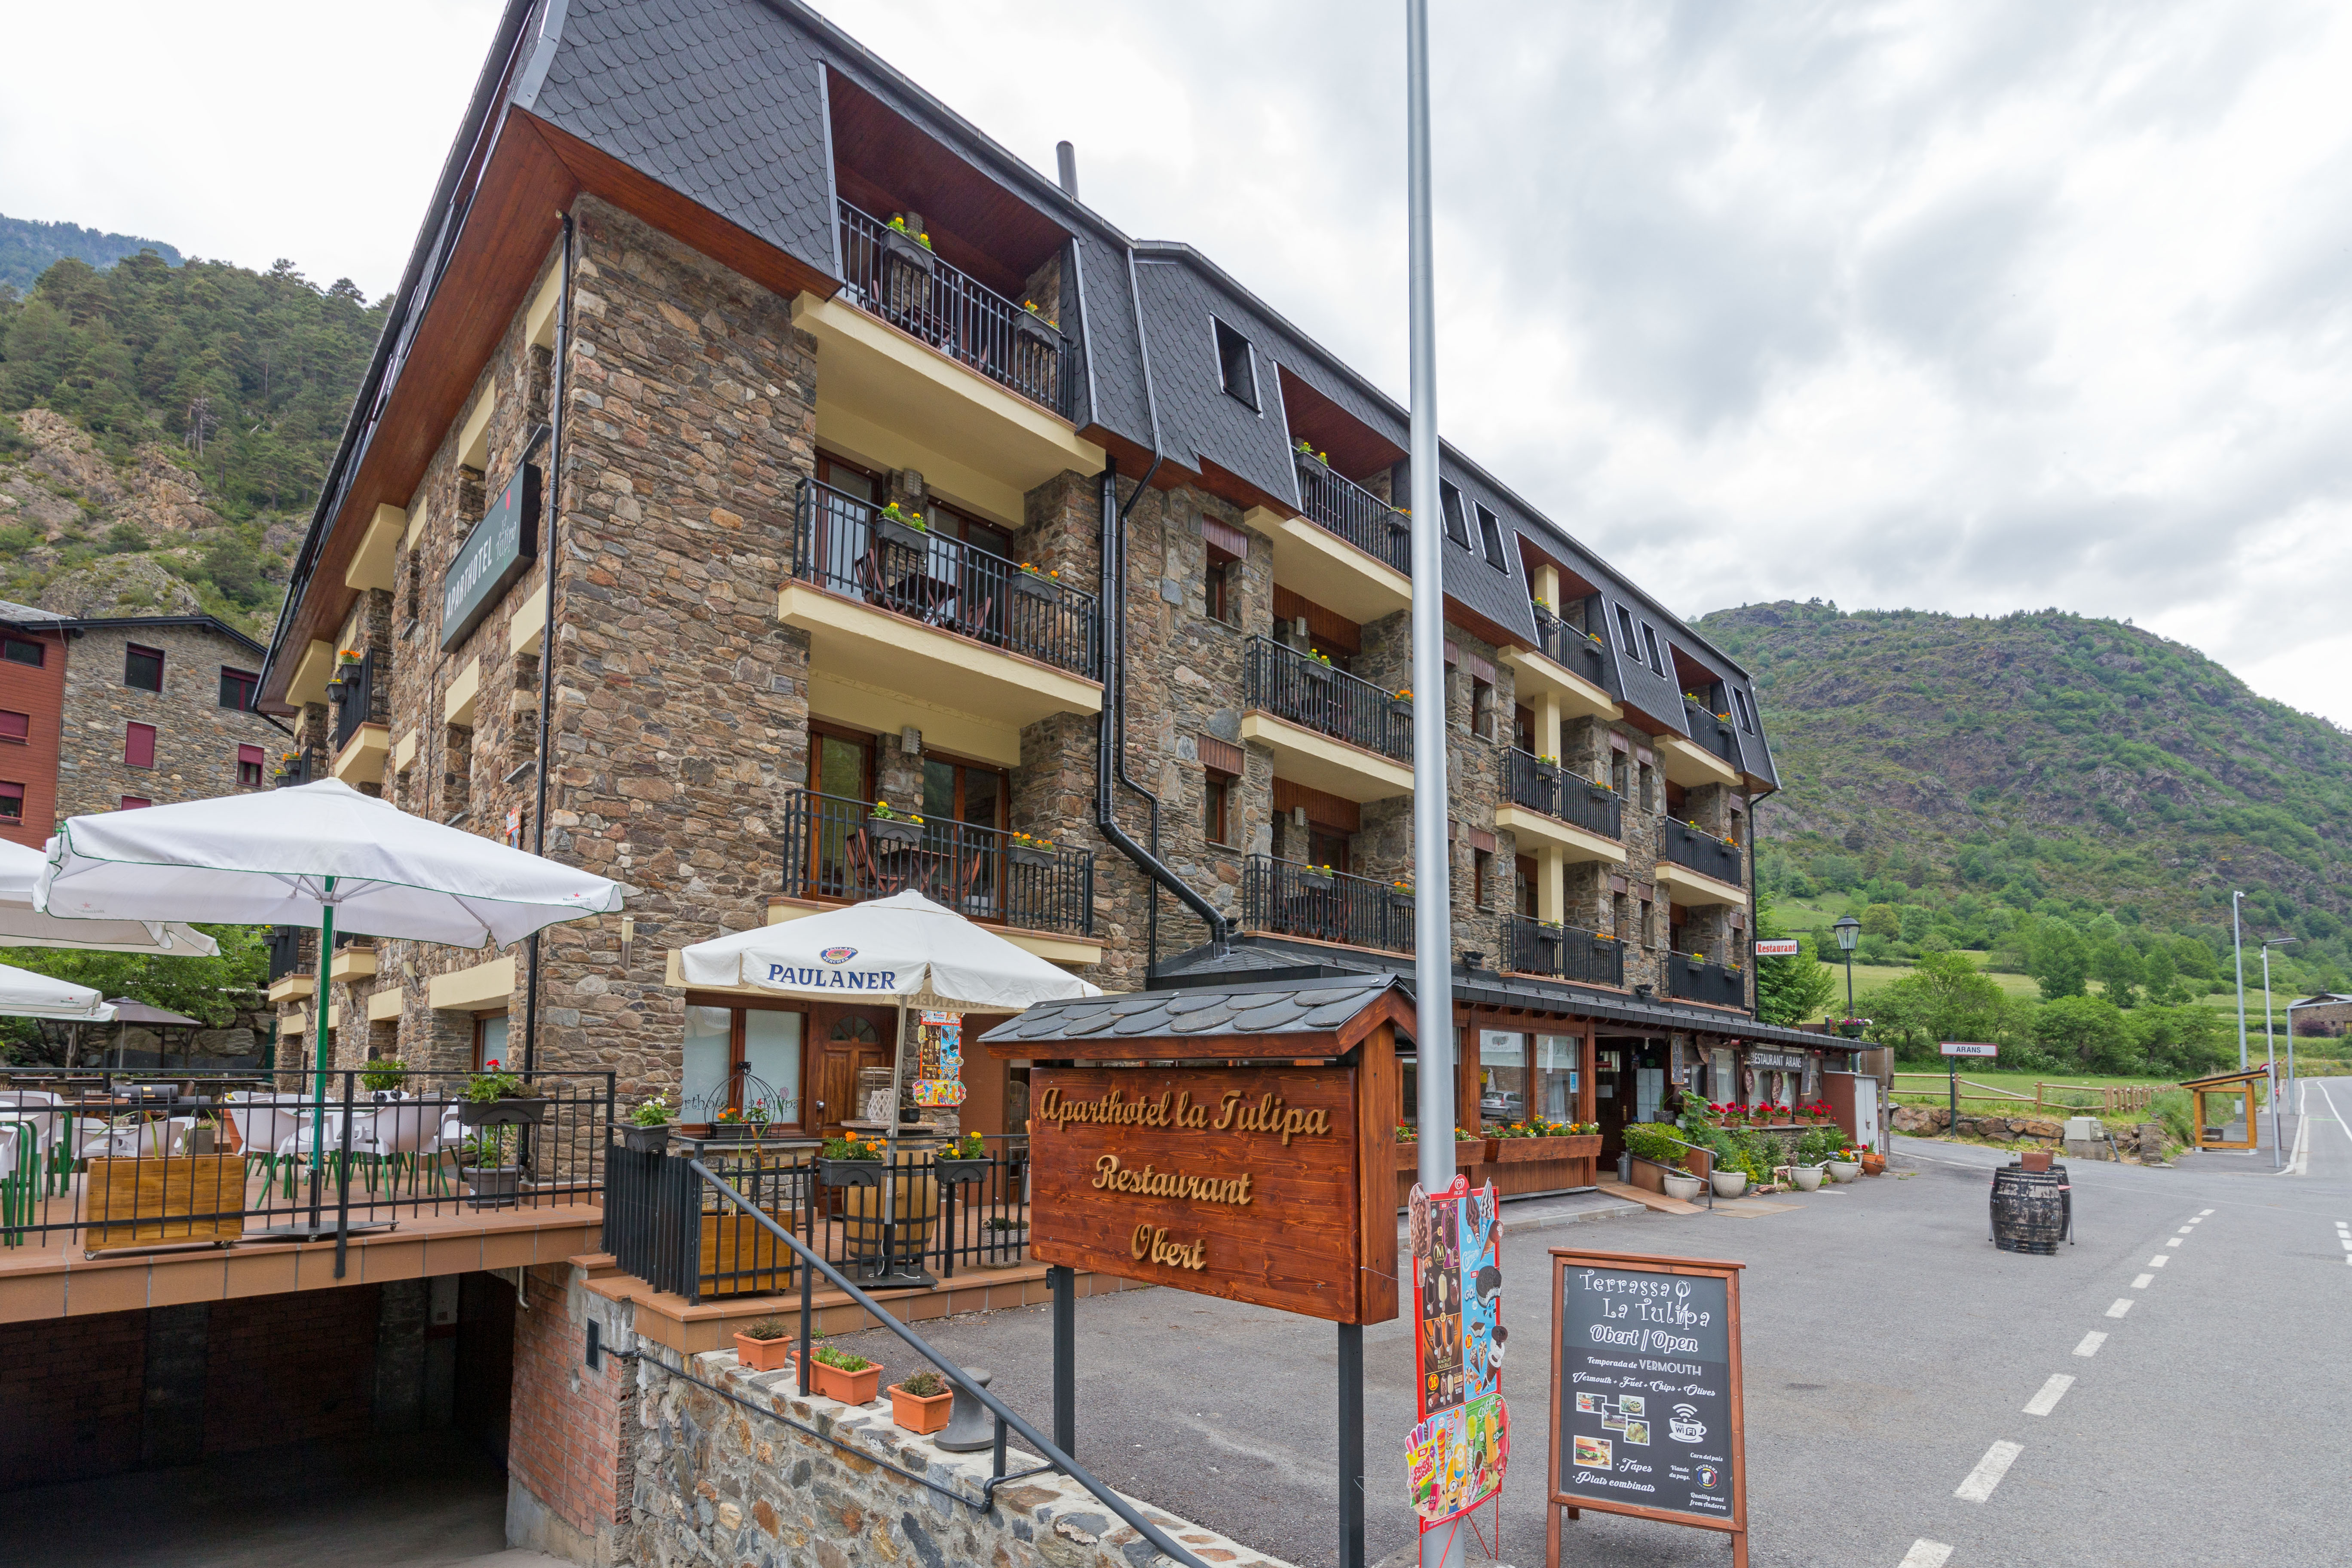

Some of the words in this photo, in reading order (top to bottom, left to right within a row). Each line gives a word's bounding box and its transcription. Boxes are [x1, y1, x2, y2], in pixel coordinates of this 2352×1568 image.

[446, 536, 492, 622] APARTHOTEL
[1757, 943, 1795, 953] Restaurant
[766, 964, 895, 989] PAULANER
[1785, 1056, 1802, 1068] ARANS
[1040, 1087, 1174, 1131] Aparthotel
[1176, 1090, 1210, 1129] la
[1213, 1090, 1331, 1146] Tulipa
[1092, 1155, 1253, 1205] Restaurant
[1131, 1224, 1207, 1270] Obert
[1436, 1245, 1444, 1258] M
[1579, 1269, 1670, 1297] Terrassa
[1465, 1288, 1476, 1301] GO!
[1602, 1298, 1628, 1319] La
[1635, 1298, 1710, 1330] Tulipa
[1466, 1335, 1472, 1348] 1€
[1590, 1324, 1639, 1346] Obert
[1651, 1330, 1698, 1354] Open
[1437, 1357, 1452, 1365] MAGNUM
[1437, 1361, 1452, 1370] DOUBLE
[1587, 1357, 1628, 1368] Temporada
[1639, 1359, 1702, 1376] VERMOUTH
[1430, 1376, 1438, 1388] 1€
[1572, 1372, 1612, 1384] Vermouth
[1619, 1376, 1643, 1388] Fuet
[1650, 1380, 1675, 1392] Chips
[1683, 1384, 1716, 1396] Olives
[1493, 1431, 1499, 1442] 50
[1619, 1458, 1652, 1473] Tapes
[1695, 1464, 1718, 1474] POLTRAND
[1575, 1471, 1608, 1485] Plats
[1609, 1480, 1655, 1492] combinats
[1690, 1492, 1711, 1501] Quality
[1703, 1501, 1726, 1510] Andorra
